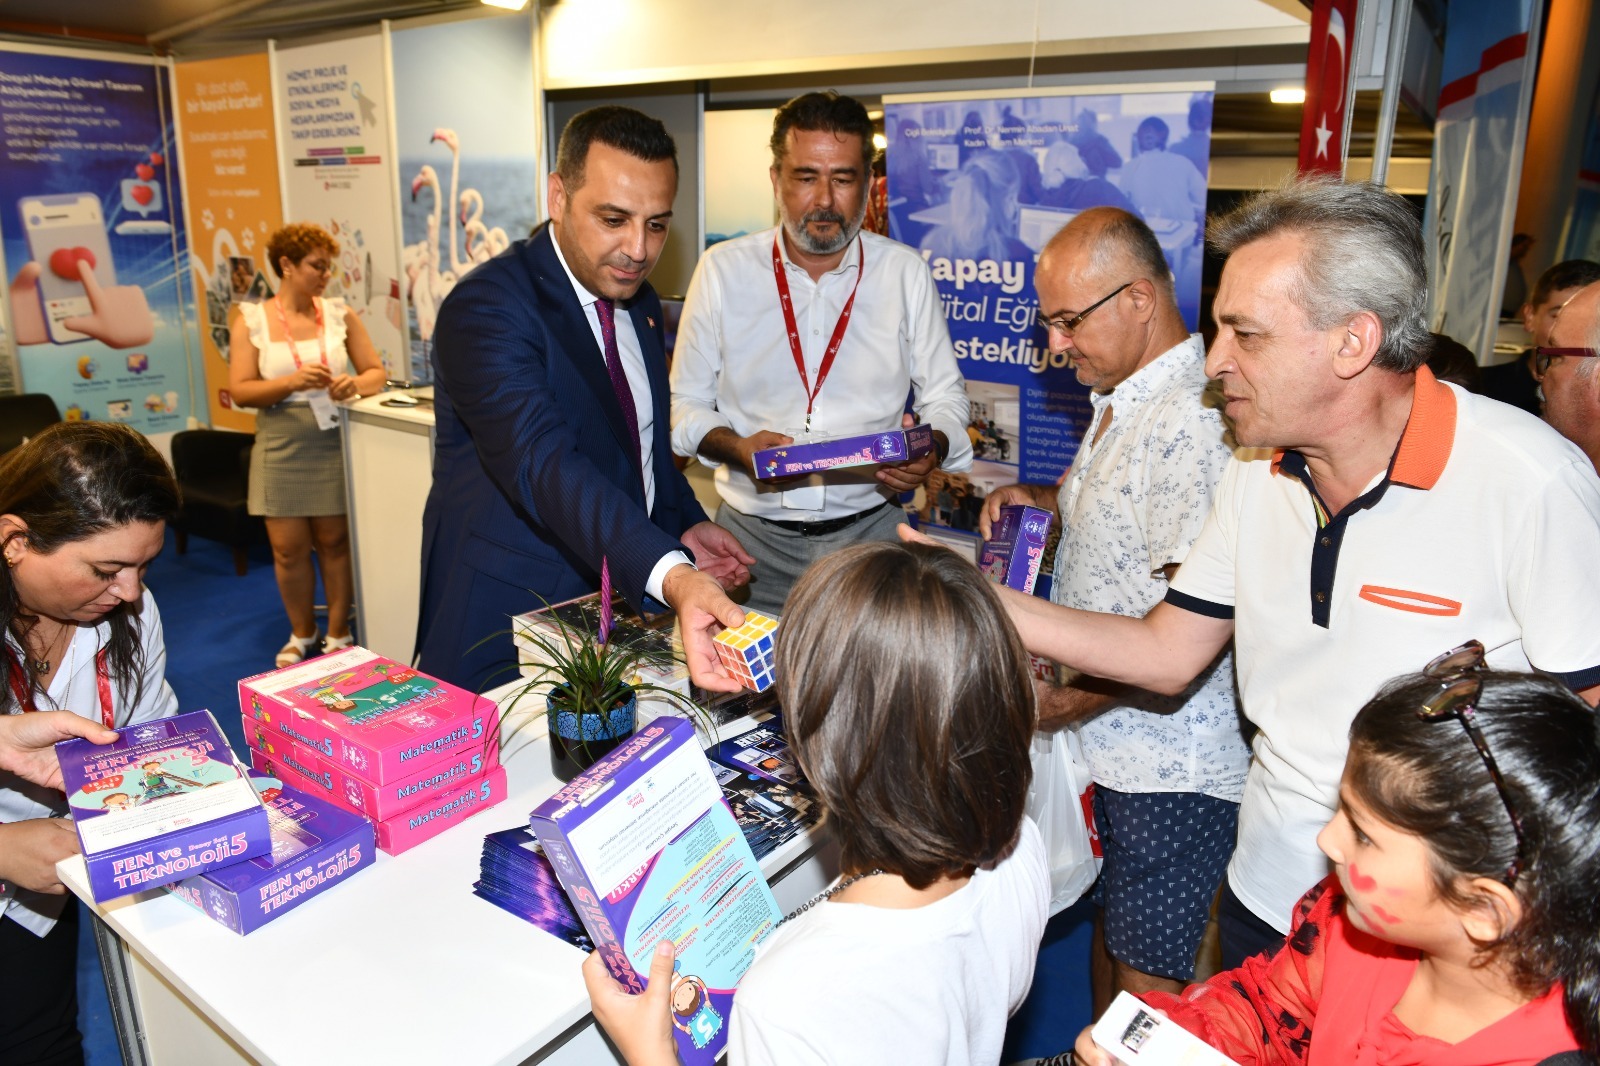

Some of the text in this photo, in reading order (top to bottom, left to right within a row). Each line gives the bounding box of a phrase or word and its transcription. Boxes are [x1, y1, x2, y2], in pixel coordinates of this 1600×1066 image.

[920, 249, 1025, 294] apay
[785, 462, 805, 473] FEN
[861, 447, 873, 463] 5
[1026, 545, 1041, 559] 5
[280, 721, 333, 756] Matematik 5
[399, 718, 483, 763] Matematik 5
[646, 726, 665, 739] 5
[190, 754, 210, 767] 5
[283, 753, 333, 790] Matematik 5
[397, 753, 482, 800] Matematik 5
[409, 780, 491, 830] Matematik 5
[231, 832, 248, 856] 5
[348, 844, 361, 867] 5
[112, 851, 154, 876] FEN
[158, 847, 182, 860] ve
[259, 873, 291, 901] FEN
[294, 866, 313, 881] ve
[571, 884, 598, 906] 5
[192, 887, 203, 908] 5
[697, 1016, 714, 1038] 5
